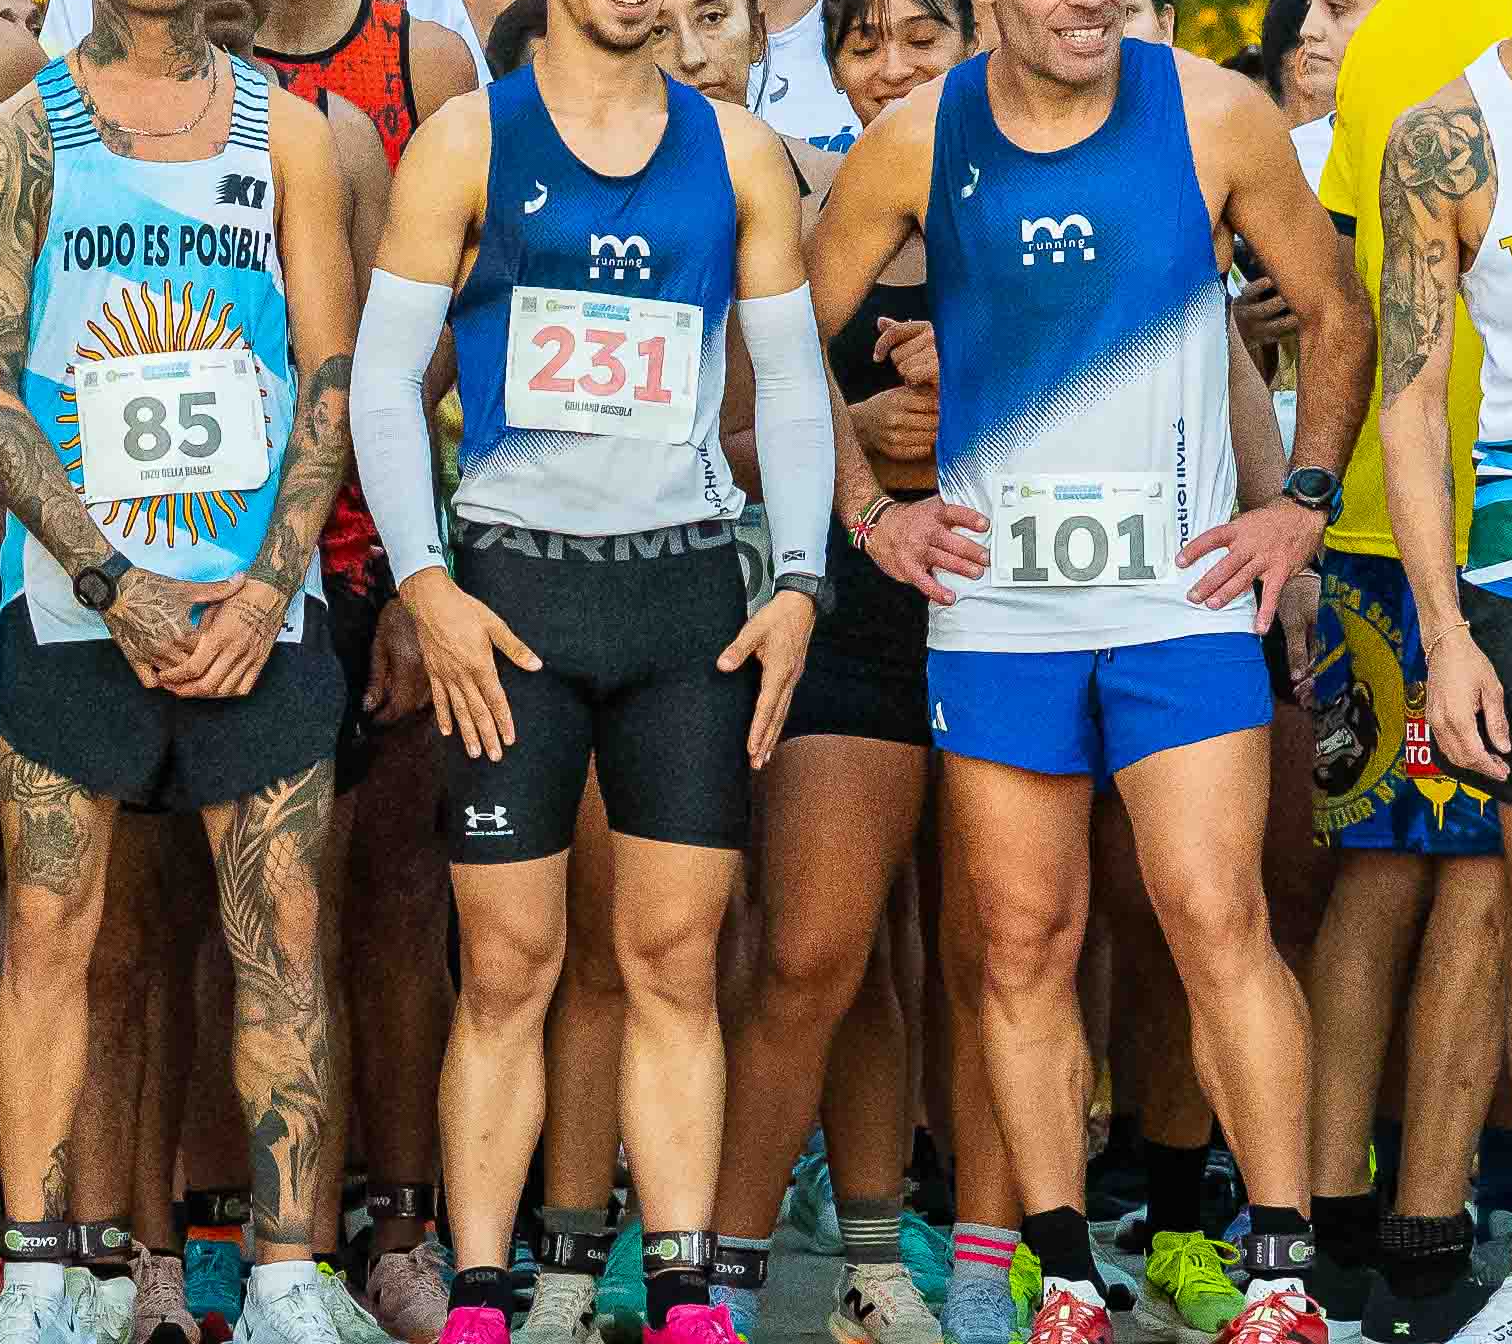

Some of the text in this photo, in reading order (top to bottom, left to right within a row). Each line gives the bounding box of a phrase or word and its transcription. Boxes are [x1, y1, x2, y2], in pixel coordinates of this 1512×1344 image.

[63, 223, 136, 273] TODO
[143, 224, 170, 268] ES
[595, 257, 643, 268] running
[1028, 238, 1085, 251] running
[528, 325, 672, 405] 231
[122, 391, 222, 462] 85
[1009, 513, 1157, 582] 101
